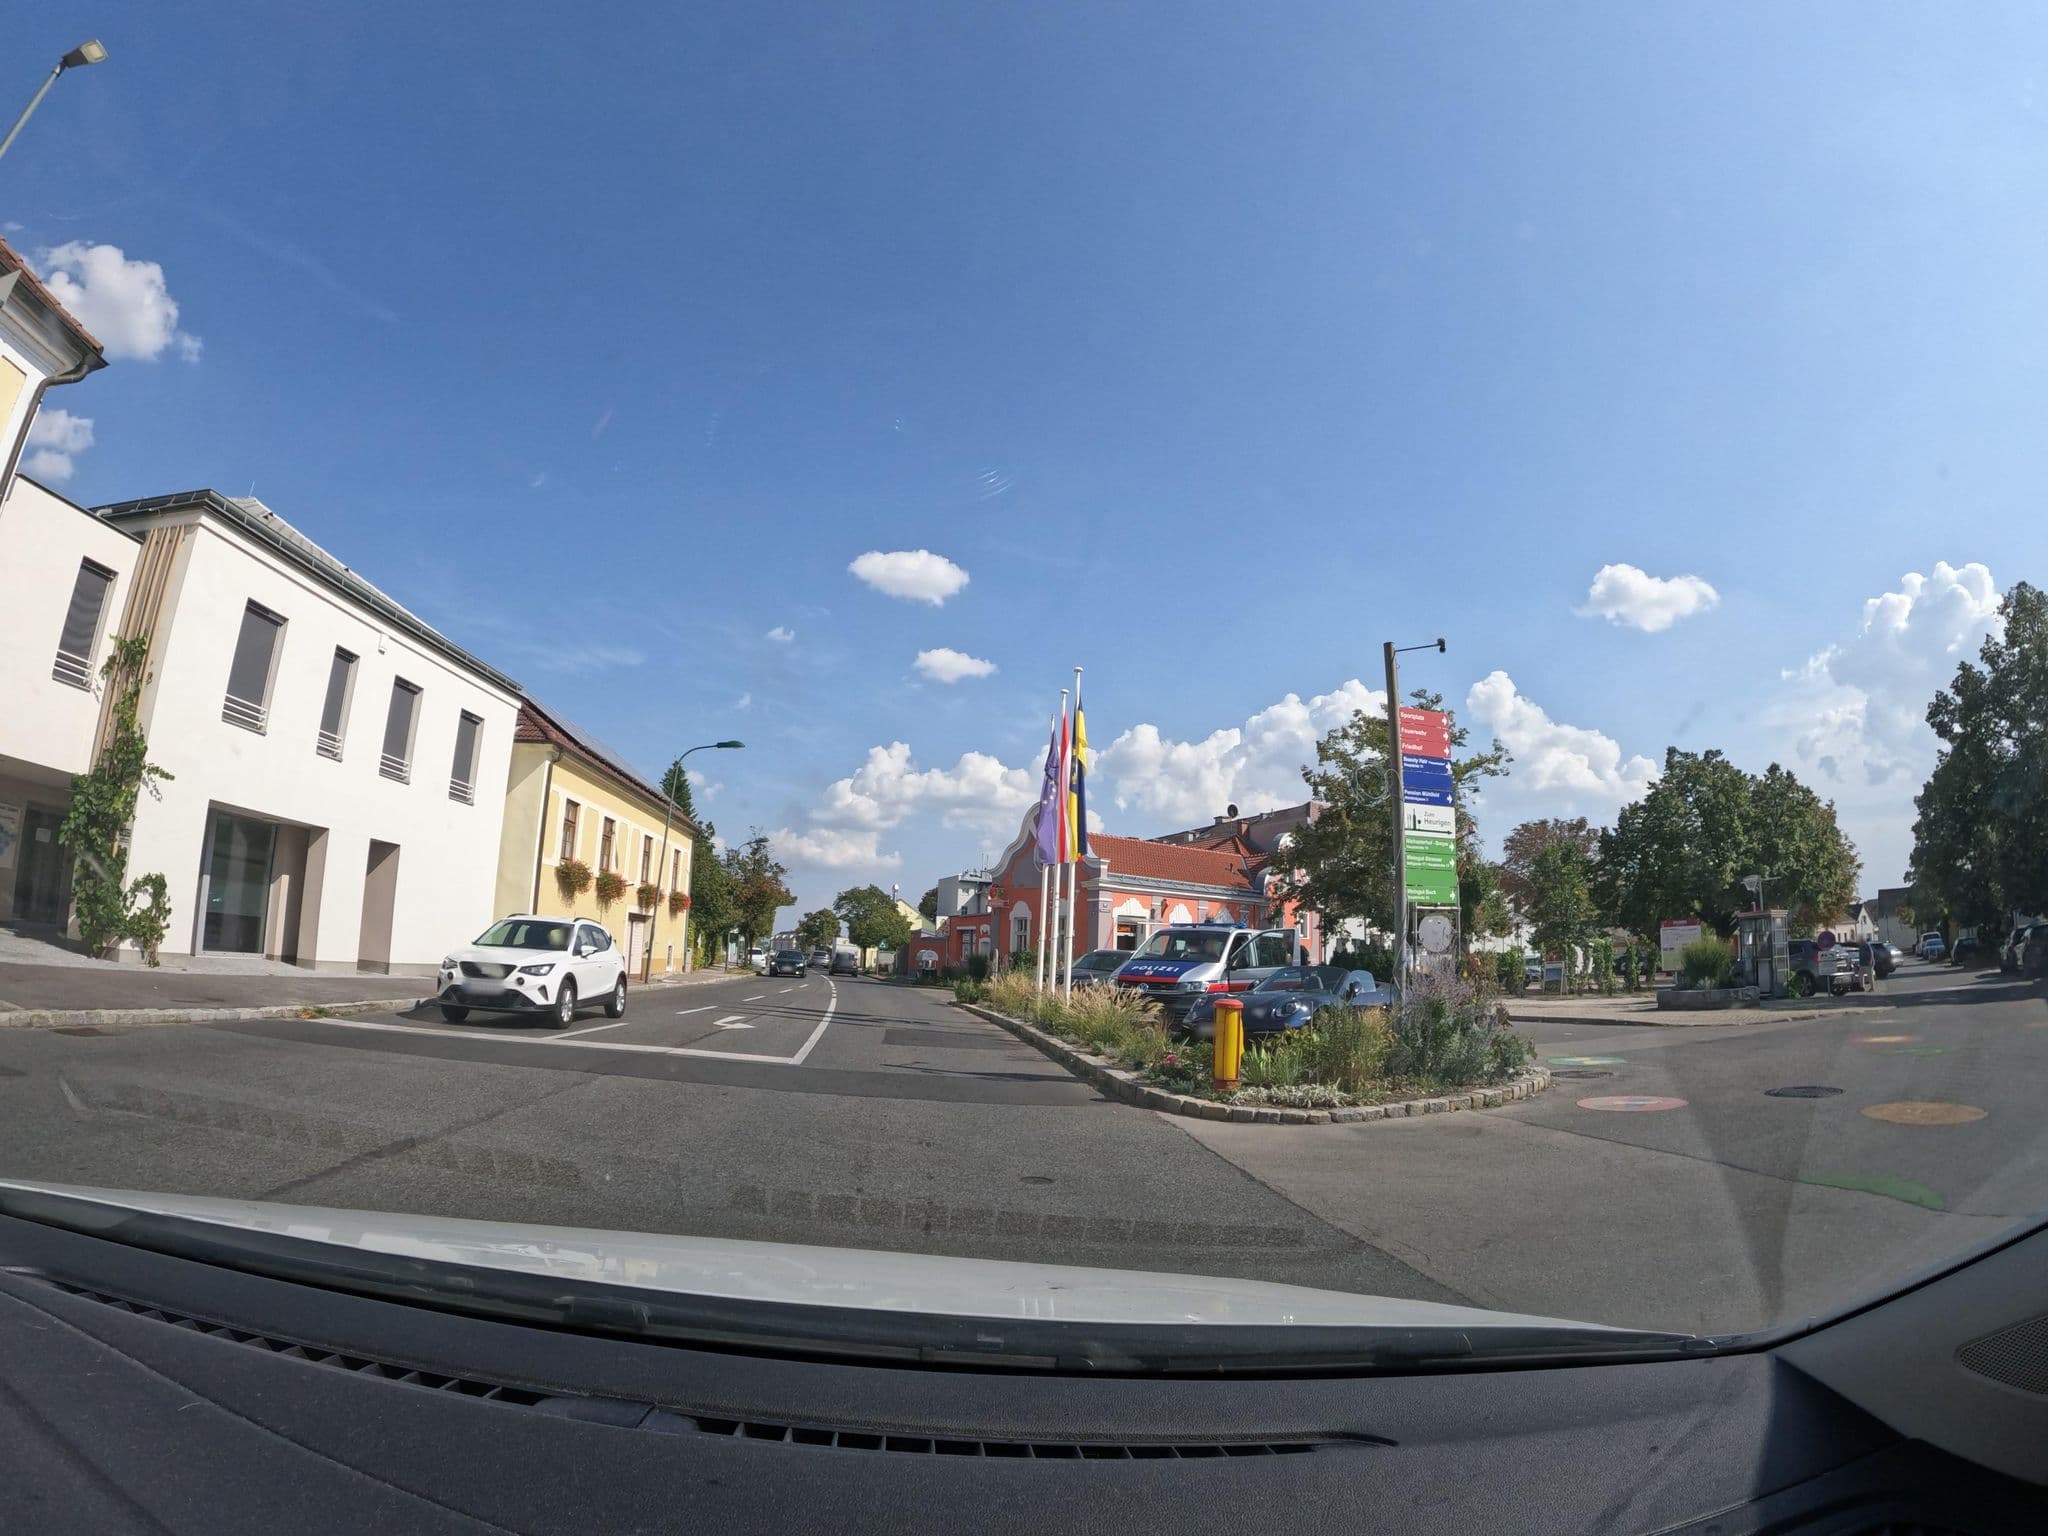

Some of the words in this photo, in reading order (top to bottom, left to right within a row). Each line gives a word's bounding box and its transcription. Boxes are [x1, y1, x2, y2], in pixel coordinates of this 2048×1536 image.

[1401, 712, 1424, 721] Sportplatz
[1401, 727, 1427, 736] Feuerwehr
[1402, 743, 1423, 751] Friedhof
[1424, 817, 1451, 827] Heurigen
